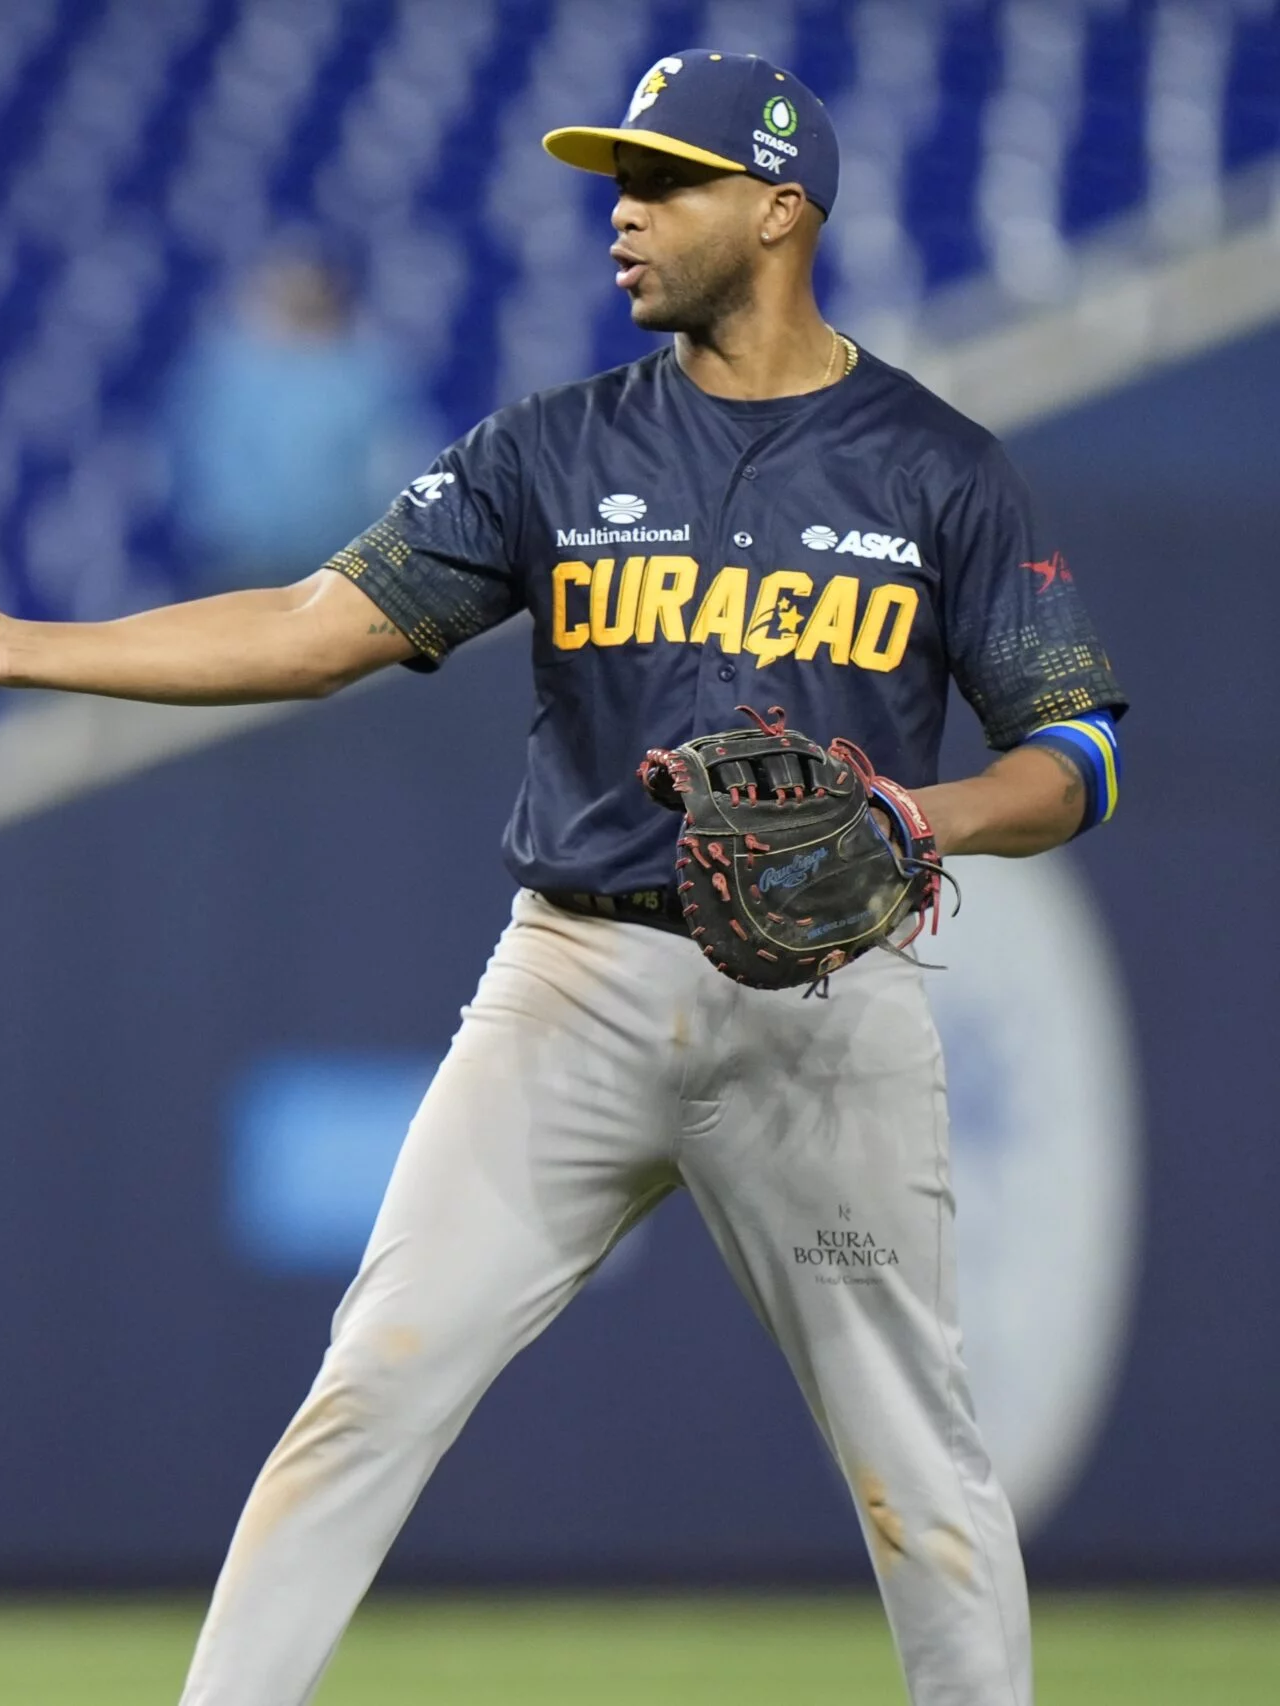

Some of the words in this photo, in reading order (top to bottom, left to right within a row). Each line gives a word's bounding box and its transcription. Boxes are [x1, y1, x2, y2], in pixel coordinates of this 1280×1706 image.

[753, 130, 798, 157] CITASCO
[556, 524, 690, 547] Multinational
[835, 530, 922, 567] ASKA
[552, 555, 919, 673] CURAÇAO
[816, 1229, 876, 1248] KURA
[793, 1246, 899, 1267] BOTANICA
